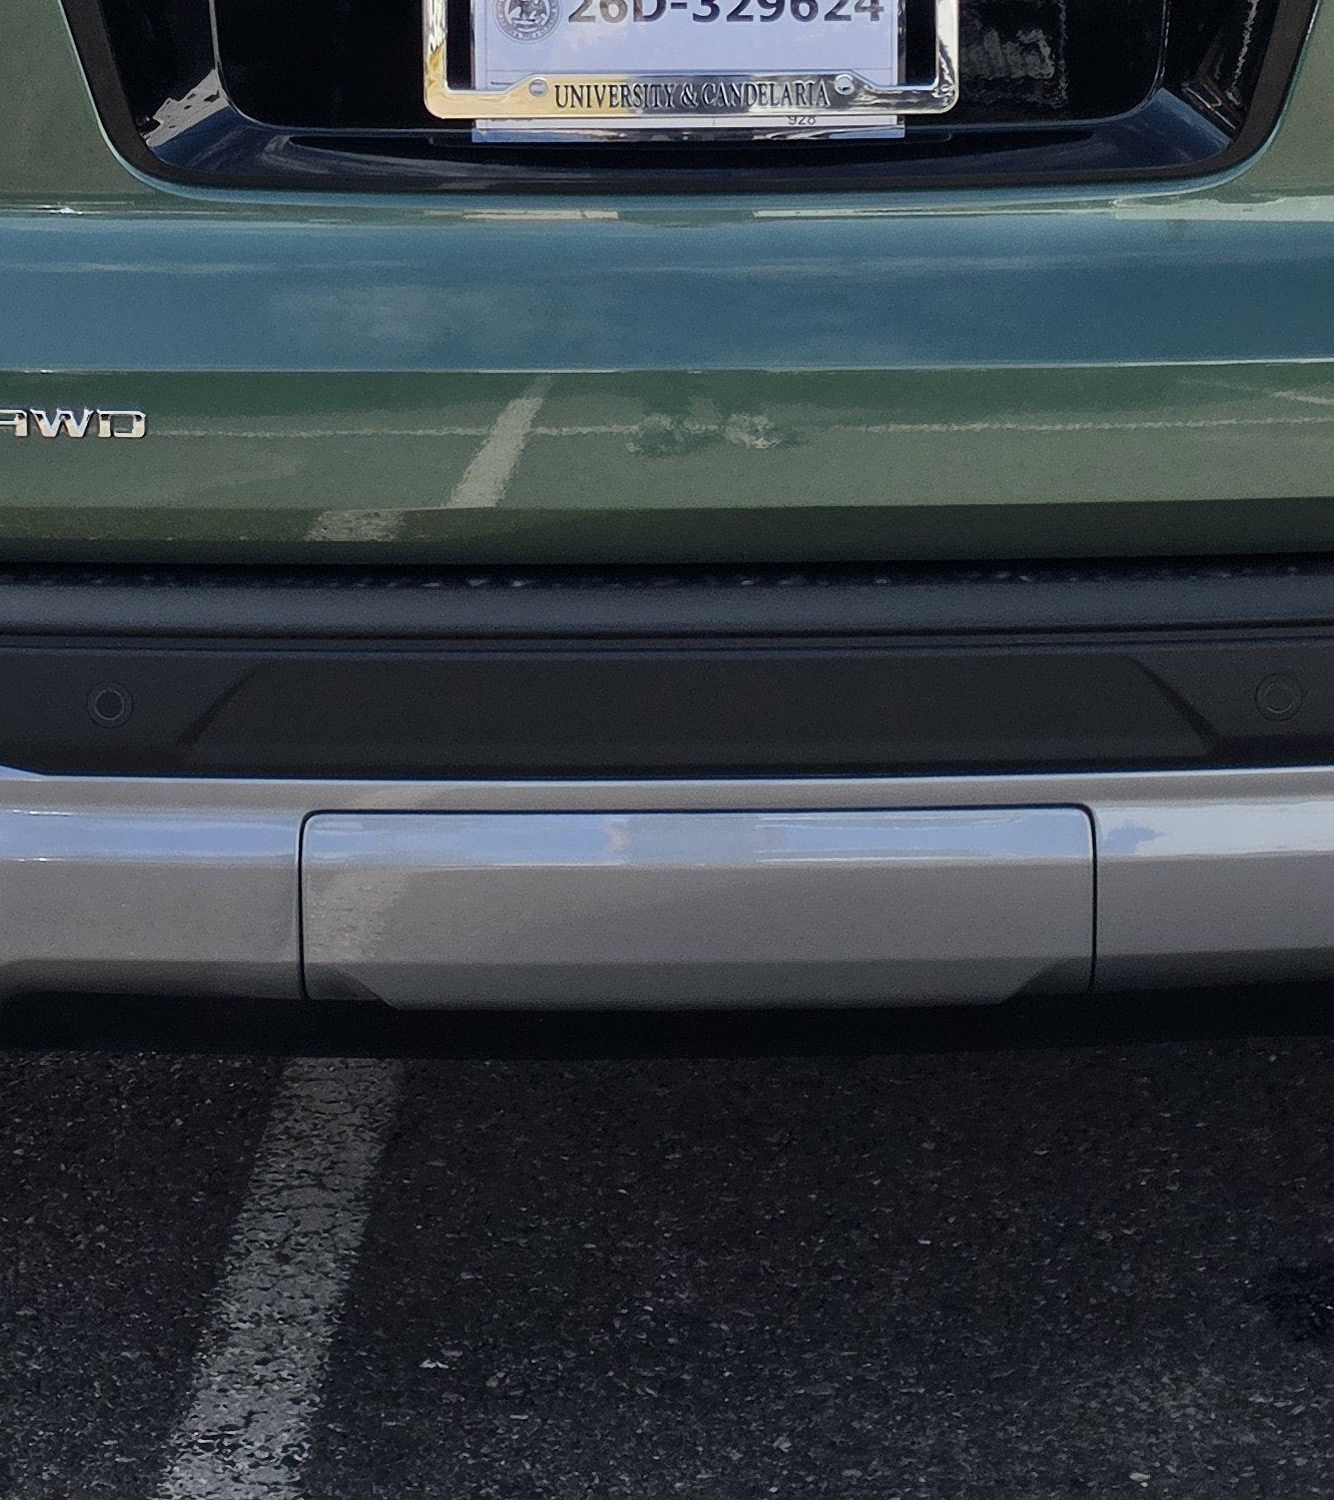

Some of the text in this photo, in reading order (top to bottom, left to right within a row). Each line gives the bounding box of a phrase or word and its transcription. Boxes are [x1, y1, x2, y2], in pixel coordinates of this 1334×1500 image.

[554, 79, 831, 109] UNIVERSITY & CANDELARIA
